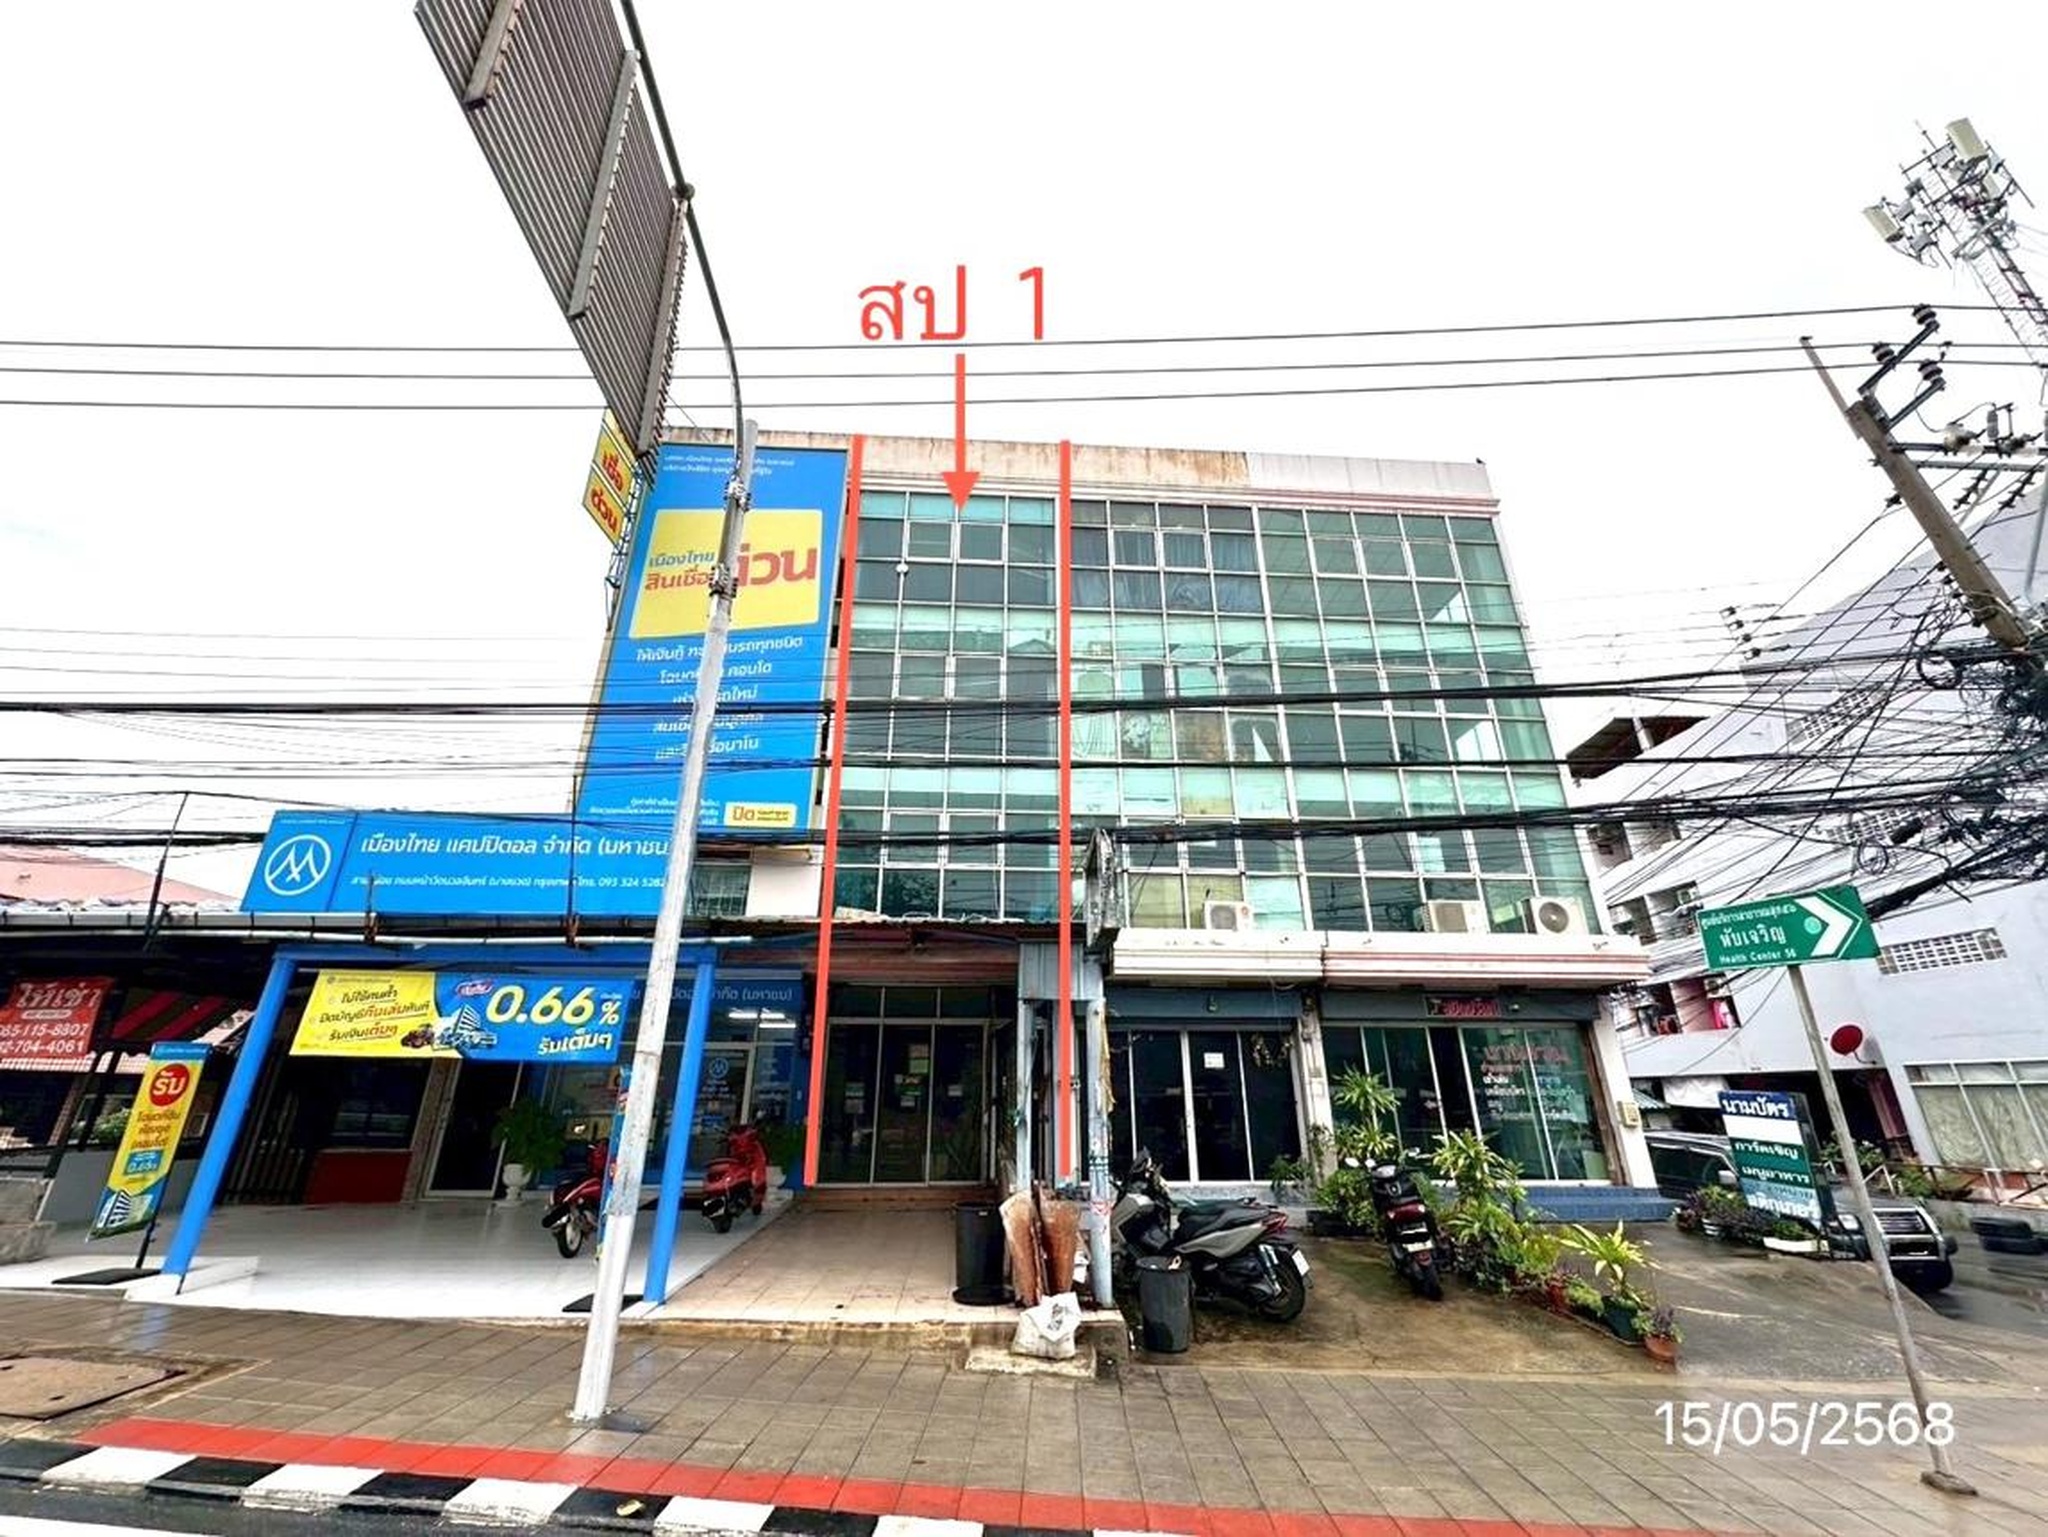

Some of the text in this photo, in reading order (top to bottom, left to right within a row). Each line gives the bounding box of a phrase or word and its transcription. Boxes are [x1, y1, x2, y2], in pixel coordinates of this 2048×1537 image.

[361, 832, 670, 855] เมืองไทย แคปปิตอล จำกัด (มหาชน
[1719, 924, 1787, 948] ทับเจริญ
[1719, 954, 1747, 965] Health
[1750, 951, 1782, 962] Center
[486, 985, 596, 1025] 0.66
[537, 1027, 613, 1056] รับเต็มๆ
[153, 1070, 186, 1095] รับ
[1722, 1096, 1790, 1118] นามบัตร
